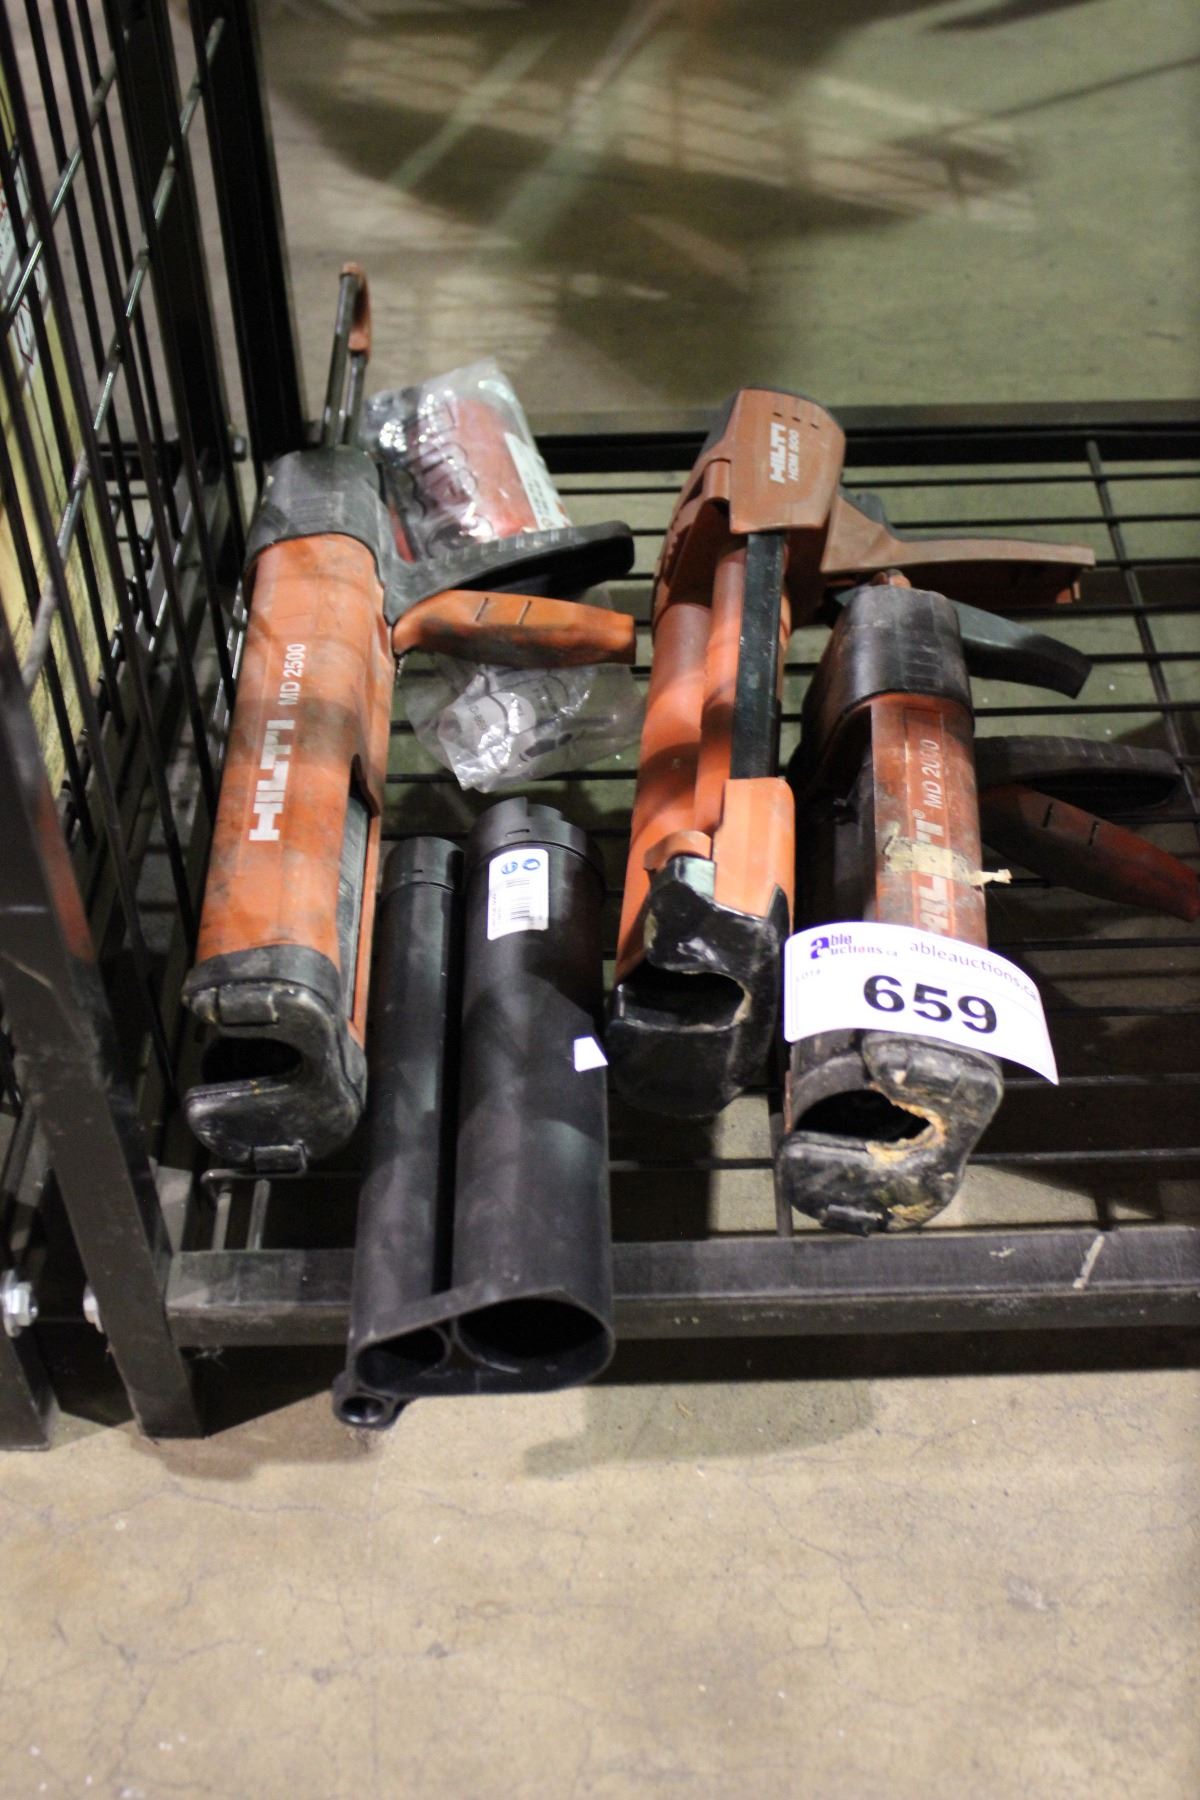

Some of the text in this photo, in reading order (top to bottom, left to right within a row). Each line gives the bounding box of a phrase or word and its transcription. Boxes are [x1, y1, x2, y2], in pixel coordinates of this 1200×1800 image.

[769, 422, 787, 484] HILTI
[249, 643, 307, 841] HILTI MD 2500
[921, 780, 943, 809] MD
[915, 817, 950, 934] HILI
[863, 974, 998, 1034] 659
